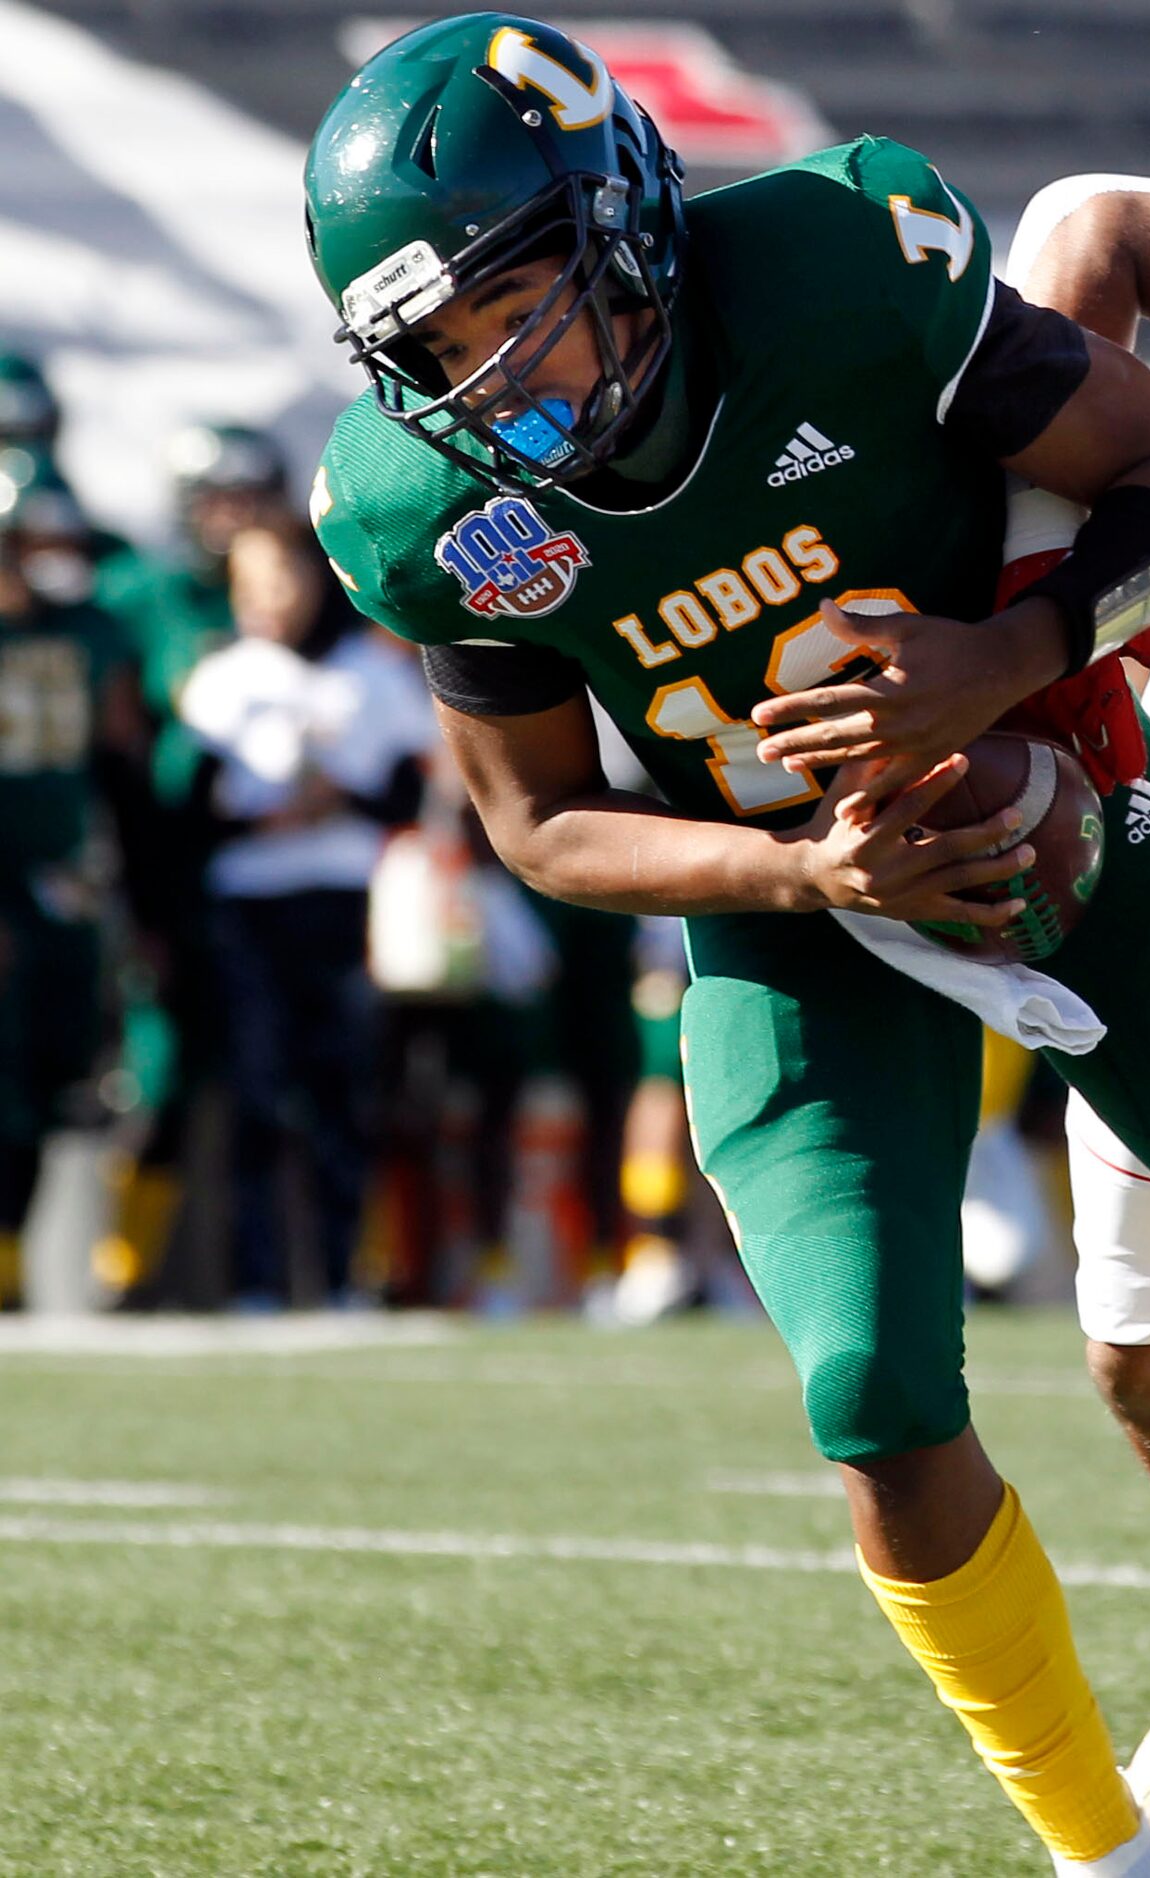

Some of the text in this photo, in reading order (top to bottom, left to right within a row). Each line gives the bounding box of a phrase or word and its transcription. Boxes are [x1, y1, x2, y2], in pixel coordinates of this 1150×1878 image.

[767, 444, 855, 487] adidas
[442, 500, 551, 592] 100
[612, 524, 840, 669] LOBOS
